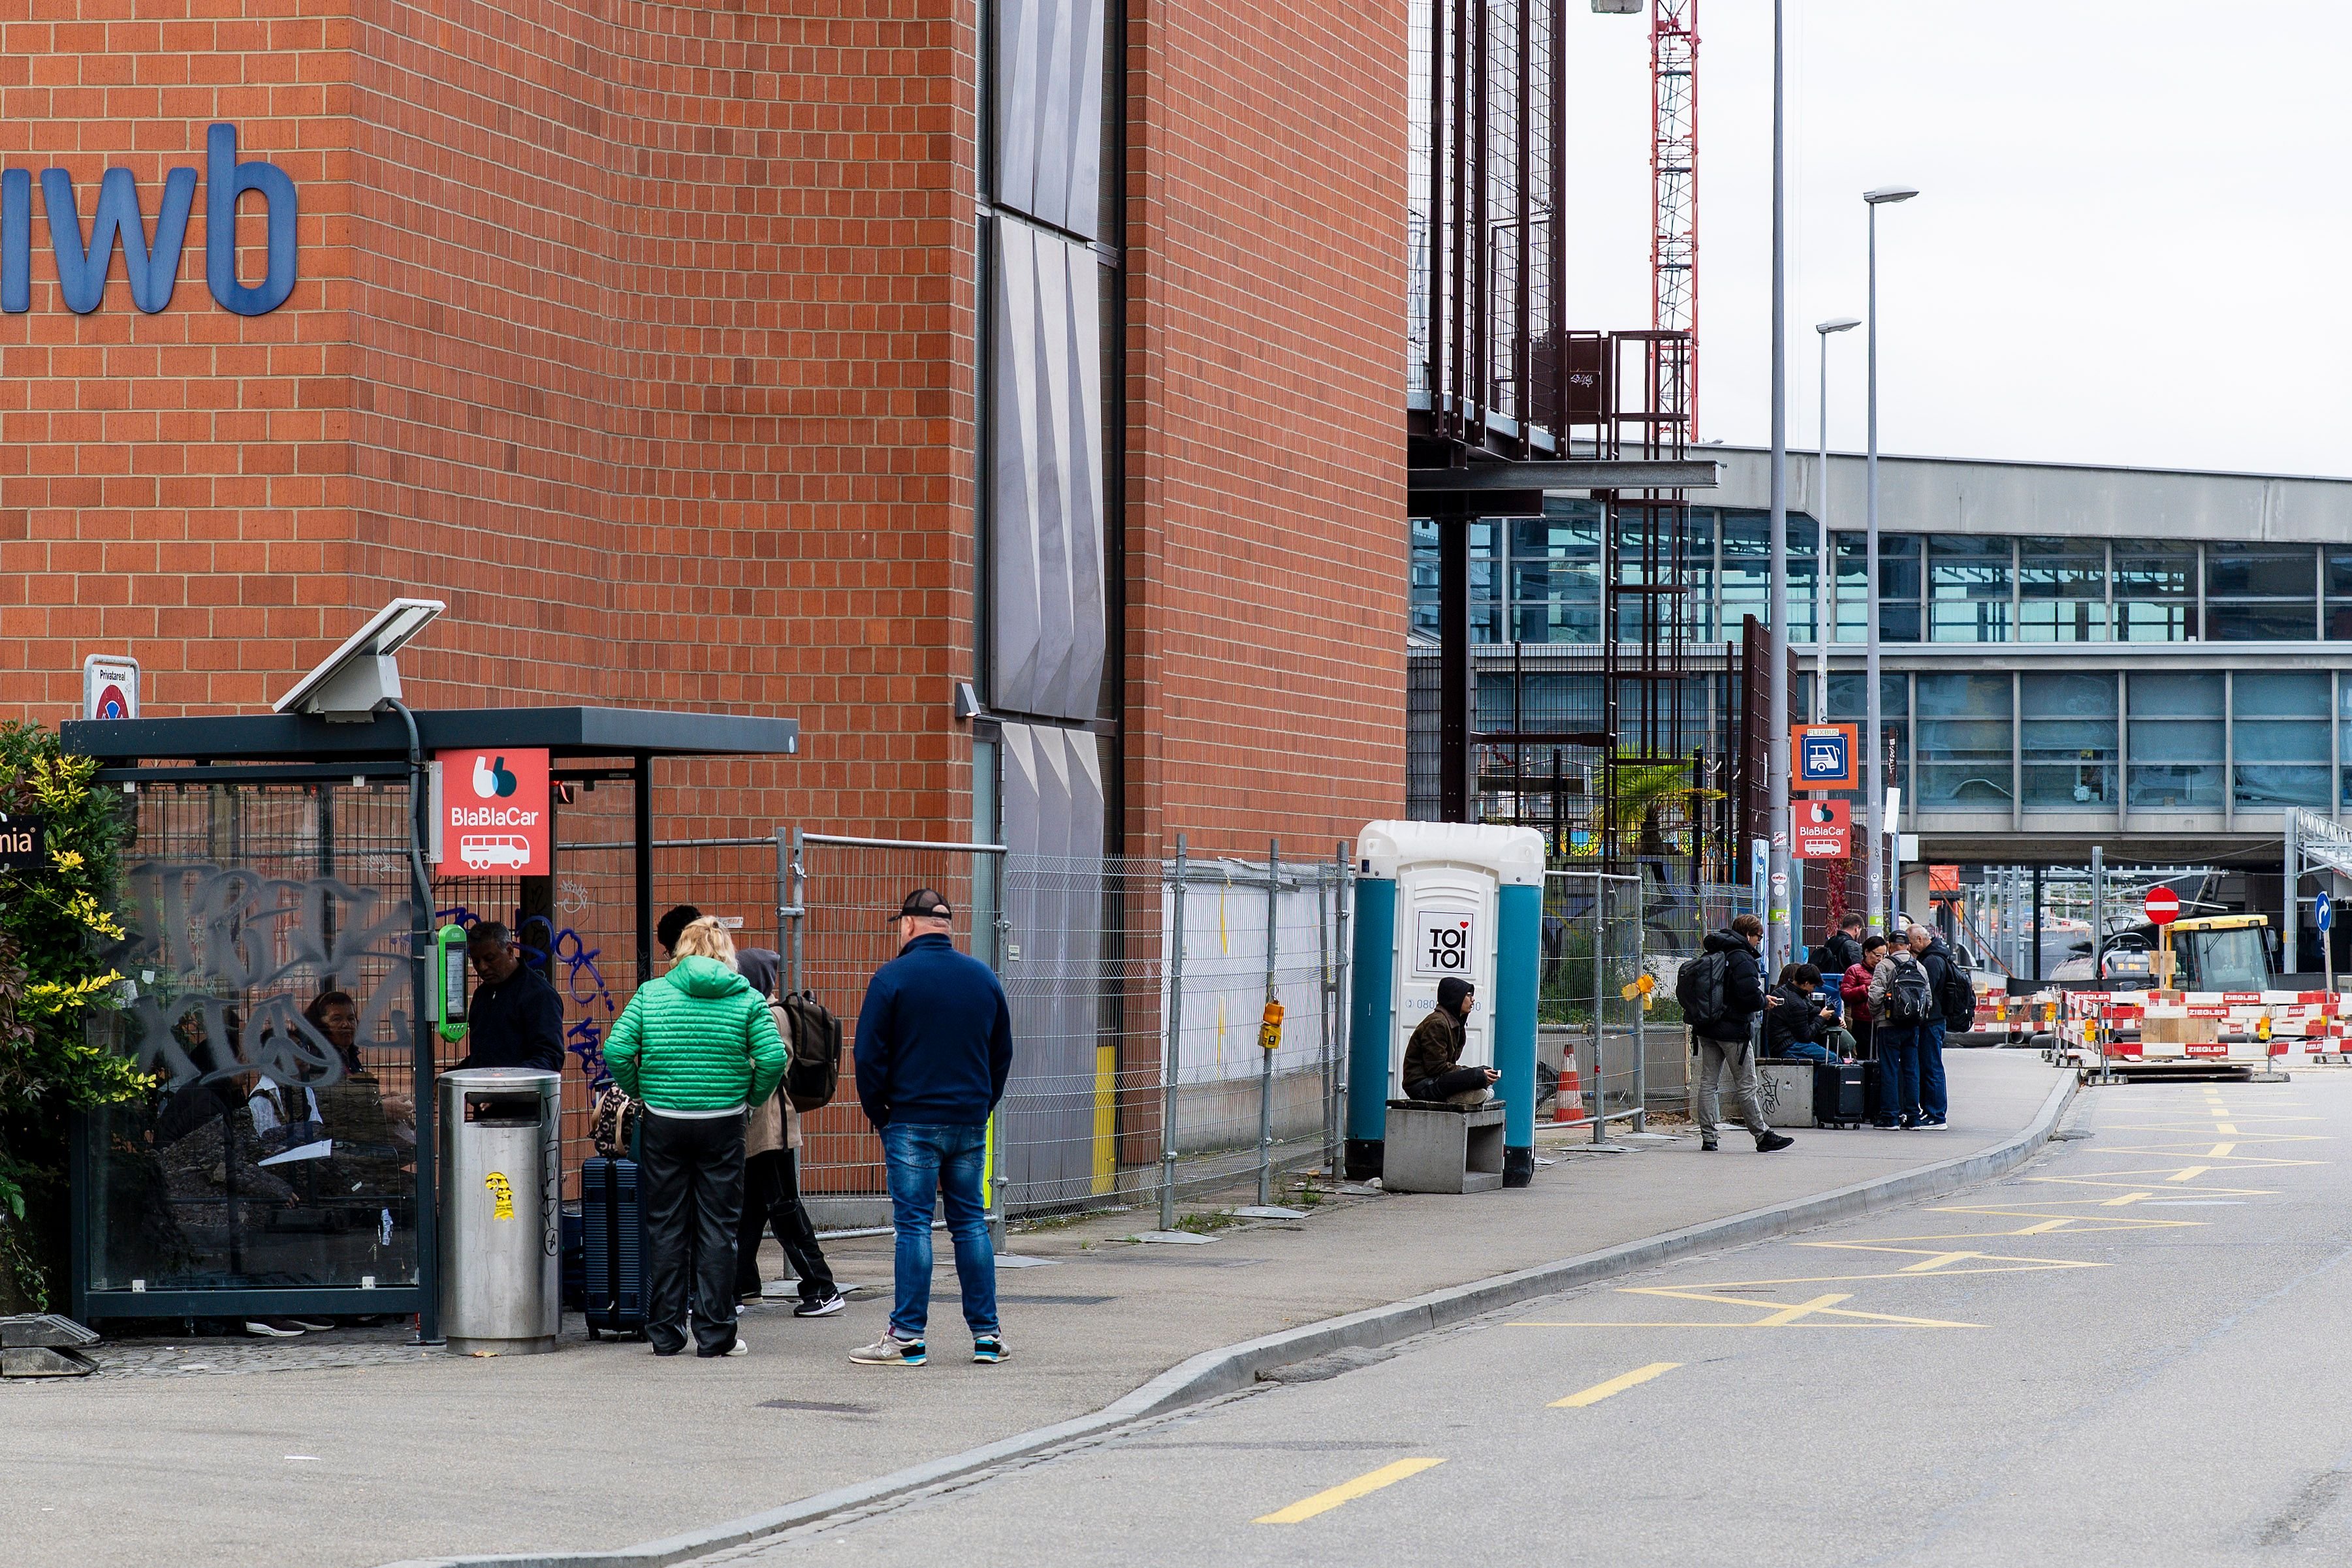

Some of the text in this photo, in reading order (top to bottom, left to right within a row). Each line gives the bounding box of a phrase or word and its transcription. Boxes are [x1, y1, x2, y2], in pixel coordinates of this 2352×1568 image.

[99, 669, 126, 682] Privatareal
[451, 807, 539, 826] BlaBlaCar
[1800, 826, 1845, 836] BlaBlaCar
[1429, 928, 1467, 949] TOI
[1429, 949, 1465, 969] TOI
[1417, 999, 1438, 1009] 080
